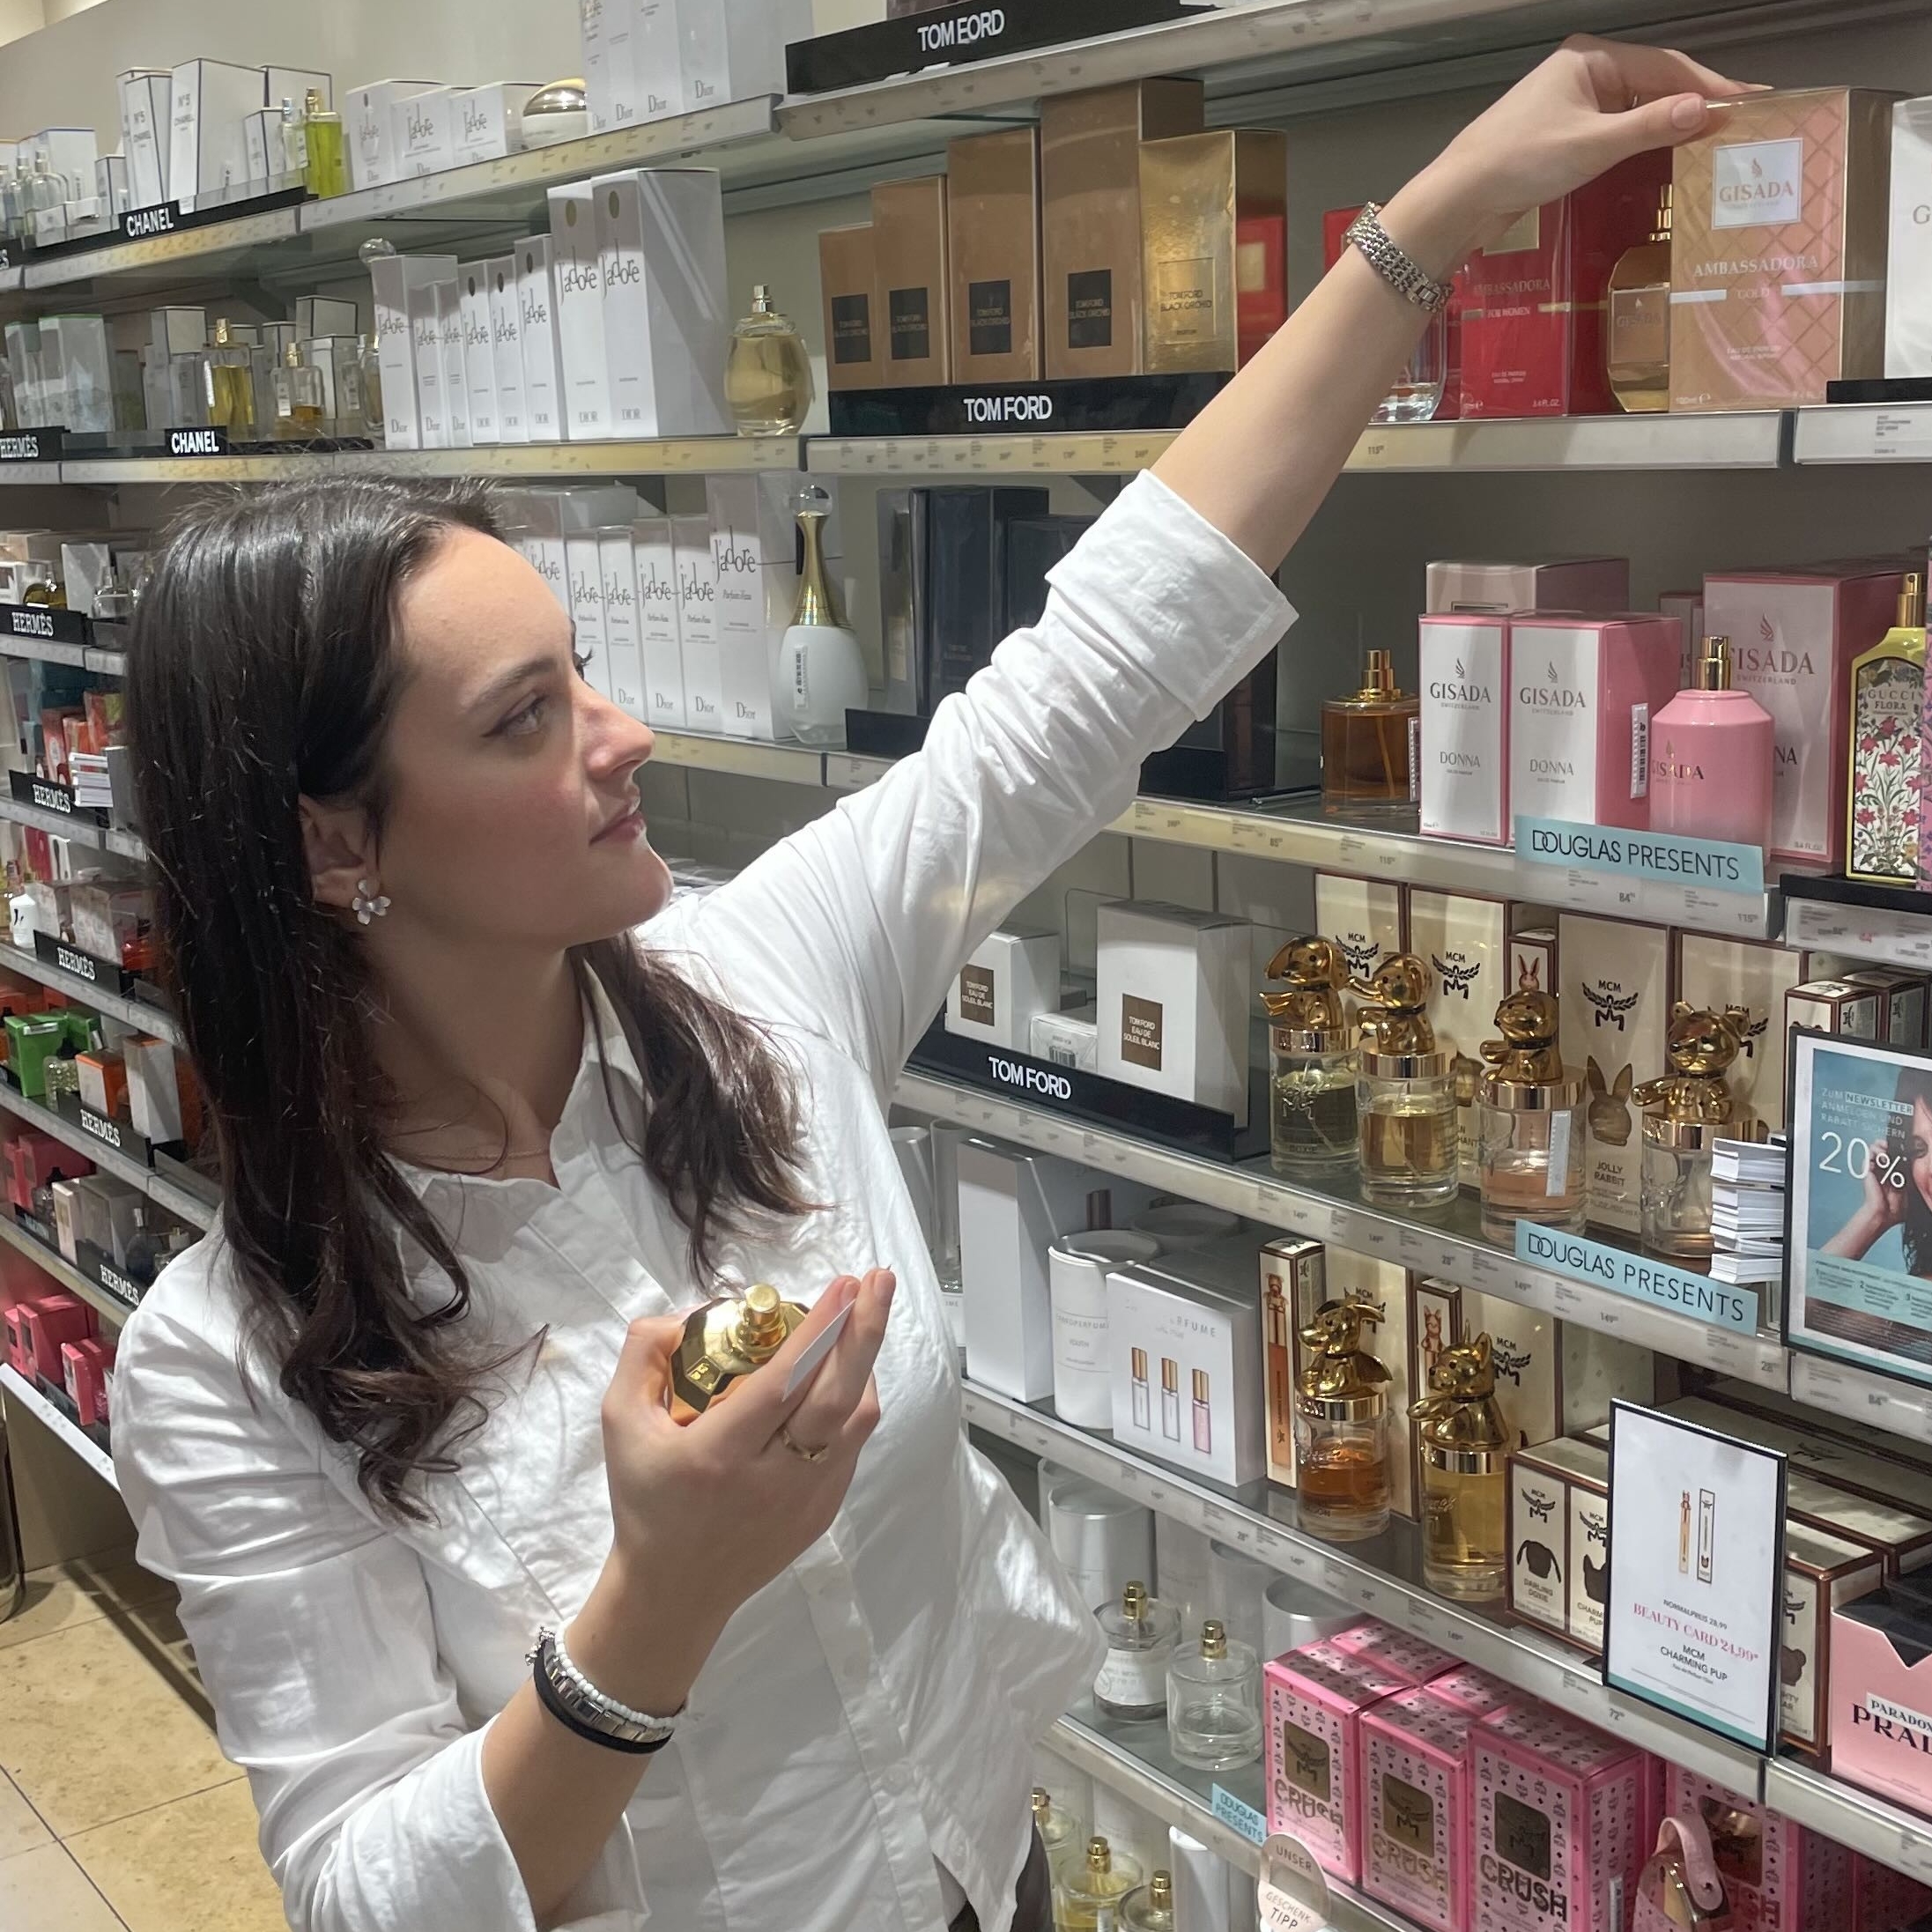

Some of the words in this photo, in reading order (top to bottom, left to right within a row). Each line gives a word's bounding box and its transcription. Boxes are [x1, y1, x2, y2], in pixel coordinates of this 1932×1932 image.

[917, 19, 955, 51] TOM
[1720, 181, 1794, 203] GISADA
[126, 207, 174, 238] CHANEL
[1694, 255, 1817, 278] AMBASSADORA
[1737, 287, 1769, 300] GOLD
[963, 397, 1002, 422] TOM
[1004, 395, 1053, 421] FORD
[171, 431, 220, 454] CHANEL
[1730, 646, 1815, 675] ISADA
[1430, 682, 1492, 703] GISADA
[1520, 687, 1586, 707] GISADA
[1868, 689, 1914, 701] GUCCI
[1875, 701, 1906, 710] FLORA
[1440, 751, 1481, 768] DONNA
[1529, 759, 1574, 775] DONNA
[1532, 830, 1622, 862] DOUGLAS
[1628, 843, 1739, 880] PRESENTS
[1348, 933, 1366, 944] MCM
[1445, 951, 1466, 963] MCM
[1598, 980, 1622, 994] MCM
[988, 1055, 1025, 1087] TOM
[1026, 1067, 1071, 1099] FORD
[1846, 1092, 1913, 1114] NEWSLETTER
[1597, 1160, 1623, 1173] JOLLY
[1594, 1172, 1625, 1187] RABBIT
[1528, 1232, 1615, 1279] DOUGLAS
[1625, 1263, 1743, 1321] PRESENTS
[1497, 1336, 1516, 1351] MCM
[1633, 1603, 1682, 1632] BEAUTY
[1684, 1625, 1719, 1647] CARD
[1660, 1646, 1708, 1674] CHARMING
[1710, 1667, 1728, 1681] PUP
[1683, 1644, 1706, 1662] MCM
[1220, 1792, 1259, 1825] DOUGLAS
[1275, 1779, 1344, 1831] CRUSH
[1216, 1804, 1263, 1843] PRESENTS
[1277, 1845, 1313, 1872] UNSER
[1479, 1854, 1567, 1923] CRUSH
[1269, 1906, 1299, 1930] TIPP
